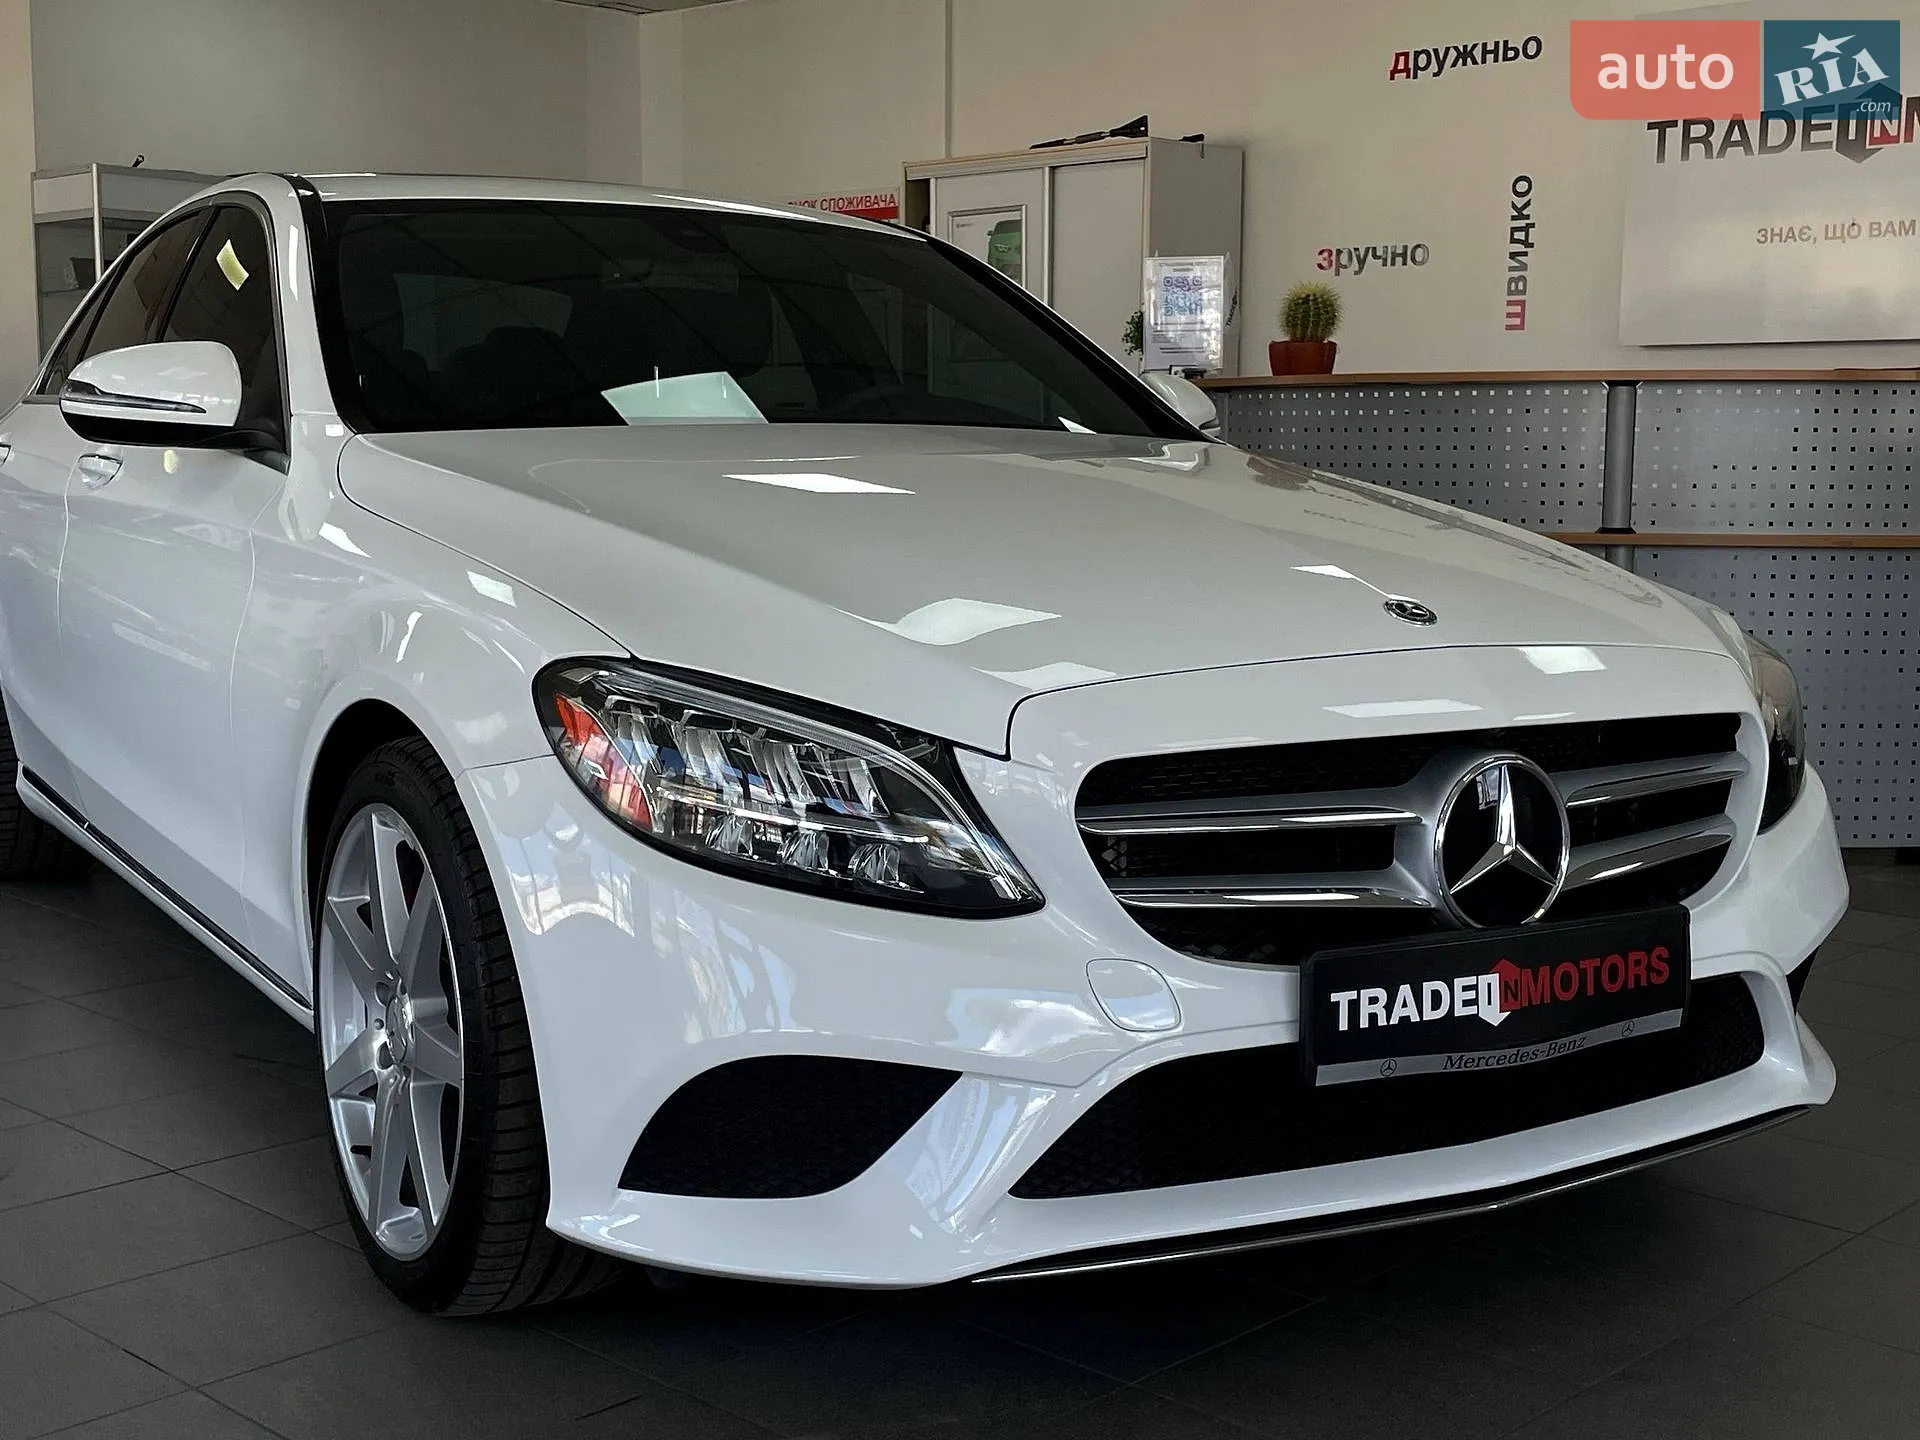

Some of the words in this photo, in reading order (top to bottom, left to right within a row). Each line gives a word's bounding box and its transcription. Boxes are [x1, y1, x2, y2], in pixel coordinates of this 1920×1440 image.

[1389, 35, 1542, 81] дружньо
[820, 194, 896, 211] СПОЖИВАЧА
[1756, 226, 1817, 245] ЗНАЄ,
[1824, 222, 1862, 243] ЩО
[1868, 219, 1917, 238] ВАМ
[1316, 243, 1429, 276] зручно
[1442, 1035, 1587, 1071] Mercedes-Benz
